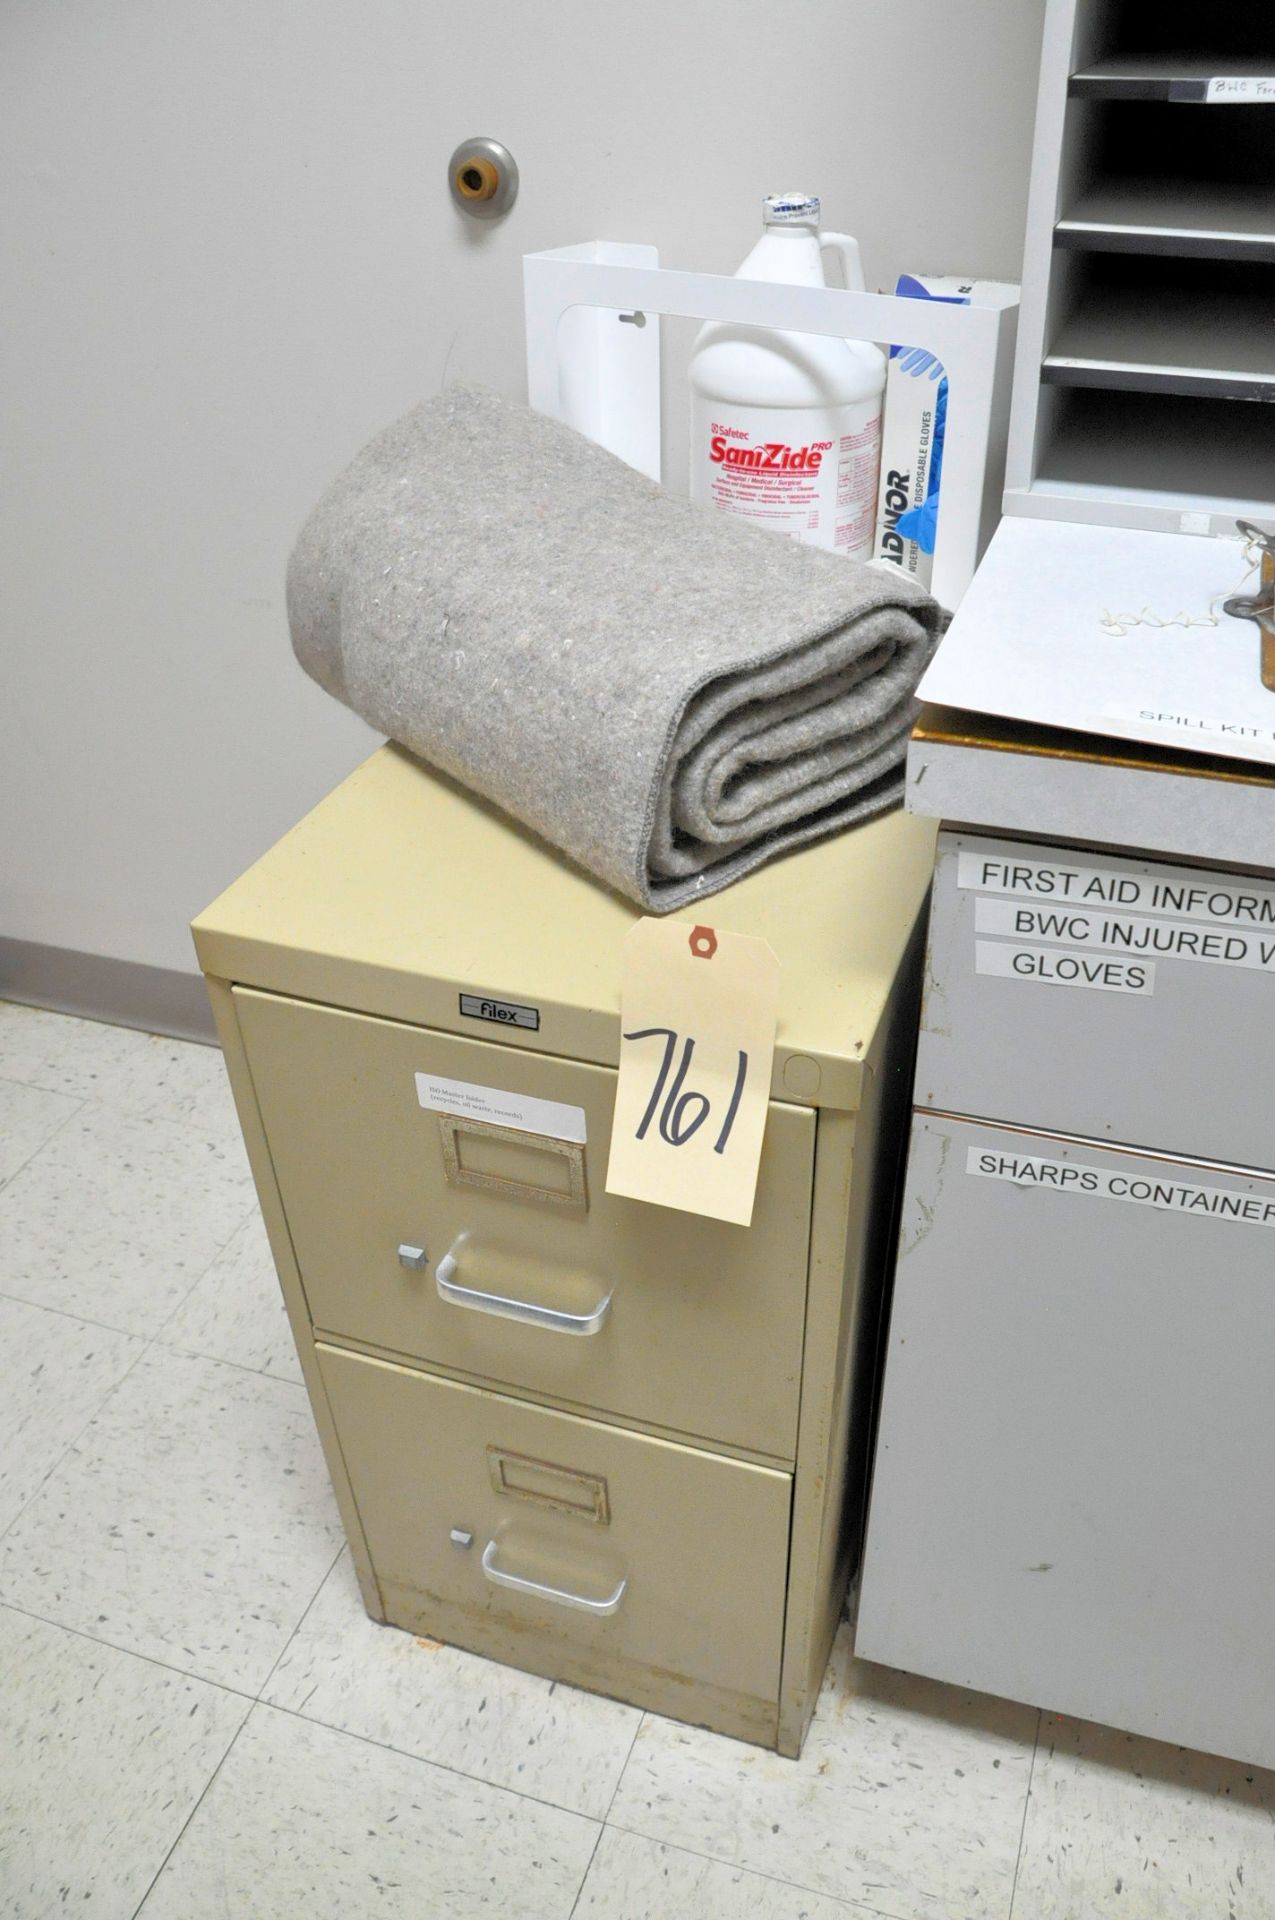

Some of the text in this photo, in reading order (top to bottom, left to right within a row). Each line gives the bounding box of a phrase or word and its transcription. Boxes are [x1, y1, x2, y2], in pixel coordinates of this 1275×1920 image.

[719, 425, 749, 440] Safetec
[920, 411, 931, 446] GLOVES
[709, 436, 822, 470] SaniZide
[810, 441, 833, 452] PRO
[778, 479, 802, 487] Surgical
[914, 448, 927, 503] DISPOSABLE
[1138, 710, 1212, 731] SPILL
[1221, 724, 1263, 738] KIT
[981, 862, 1078, 897] FIRST
[1083, 876, 1141, 904] AID
[1014, 910, 1090, 941] BWC
[1101, 921, 1248, 961] INJURED
[1012, 953, 1146, 989] GLOVES
[480, 1002, 518, 1023] filex
[623, 1028, 748, 1154] 761
[979, 1155, 1098, 1191] SHARPS
